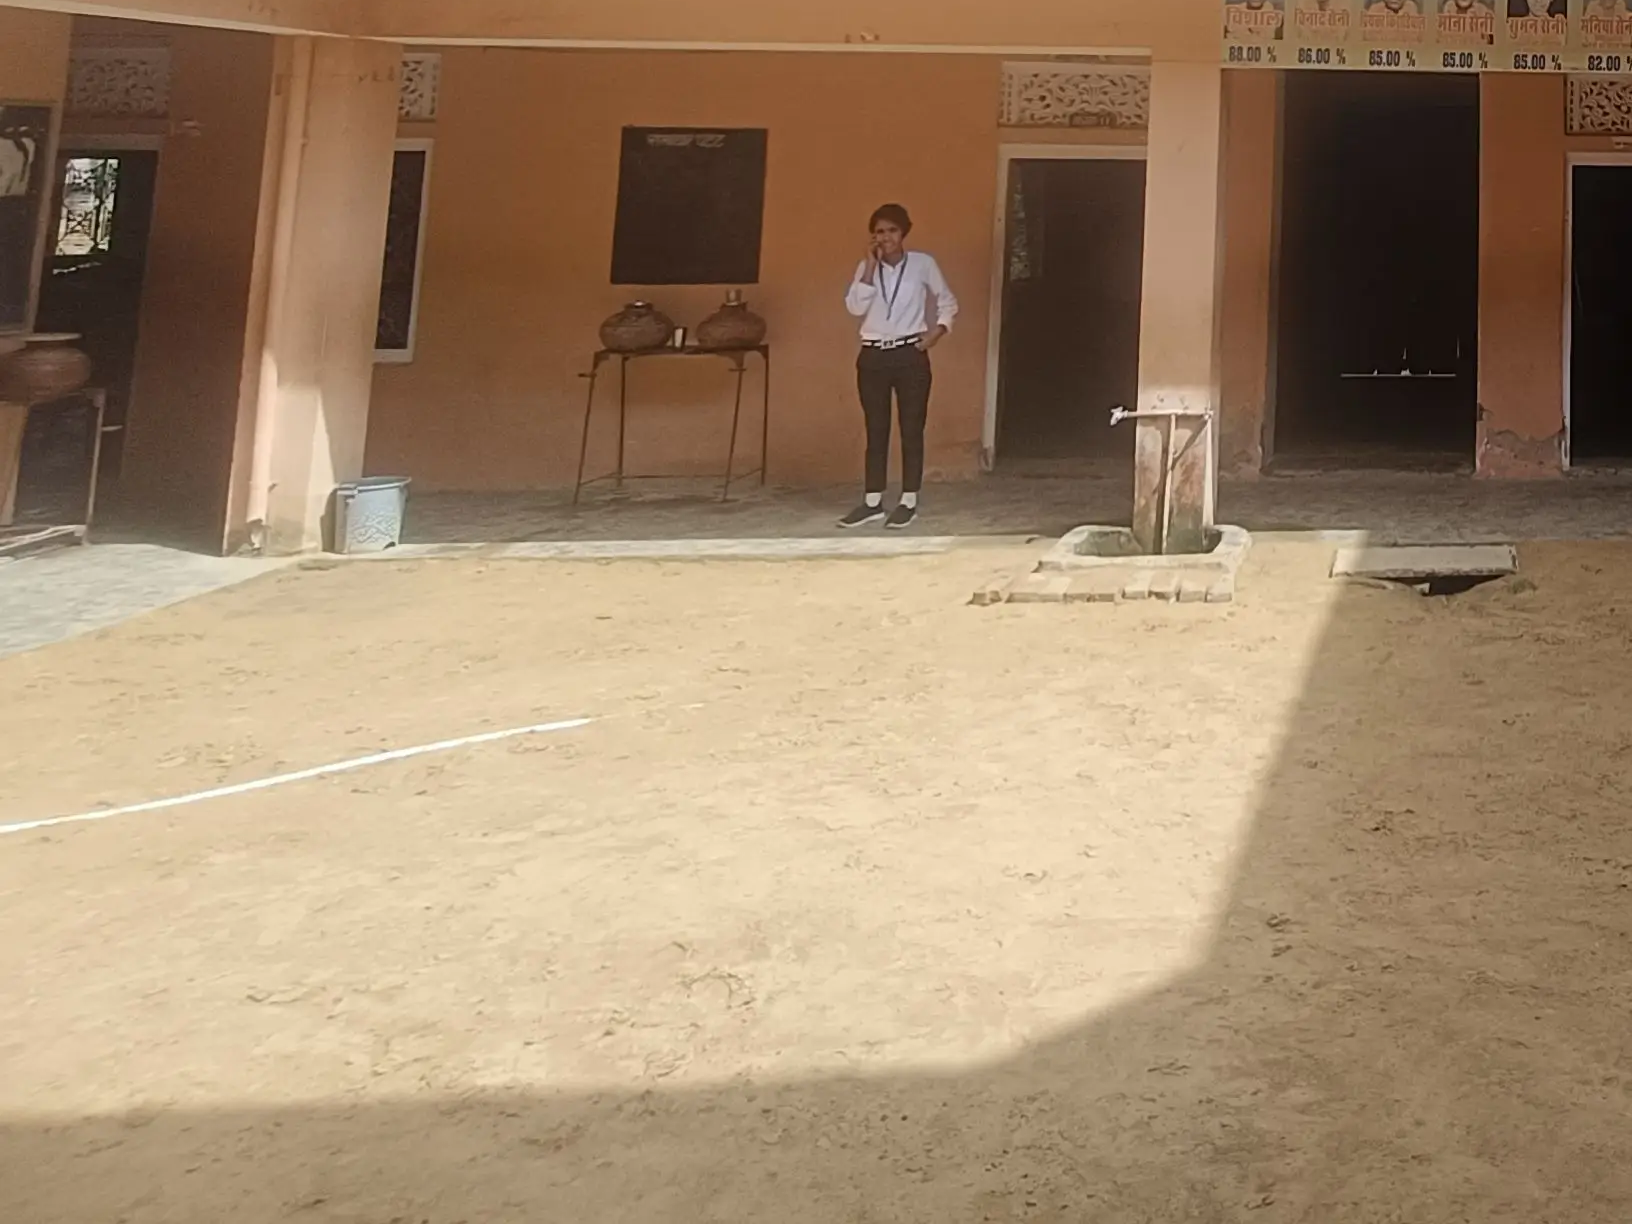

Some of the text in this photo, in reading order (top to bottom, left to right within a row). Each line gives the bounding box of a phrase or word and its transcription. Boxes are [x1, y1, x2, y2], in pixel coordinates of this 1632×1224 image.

[1229, 45, 1277, 64] 88.00 %
[1337, 47, 1347, 65] %
[1369, 50, 1417, 68] 85.00 %
[1442, 52, 1489, 69] 85.00 %
[1513, 54, 1562, 71] 85.00 %
[1588, 55, 1621, 71] 82.00
